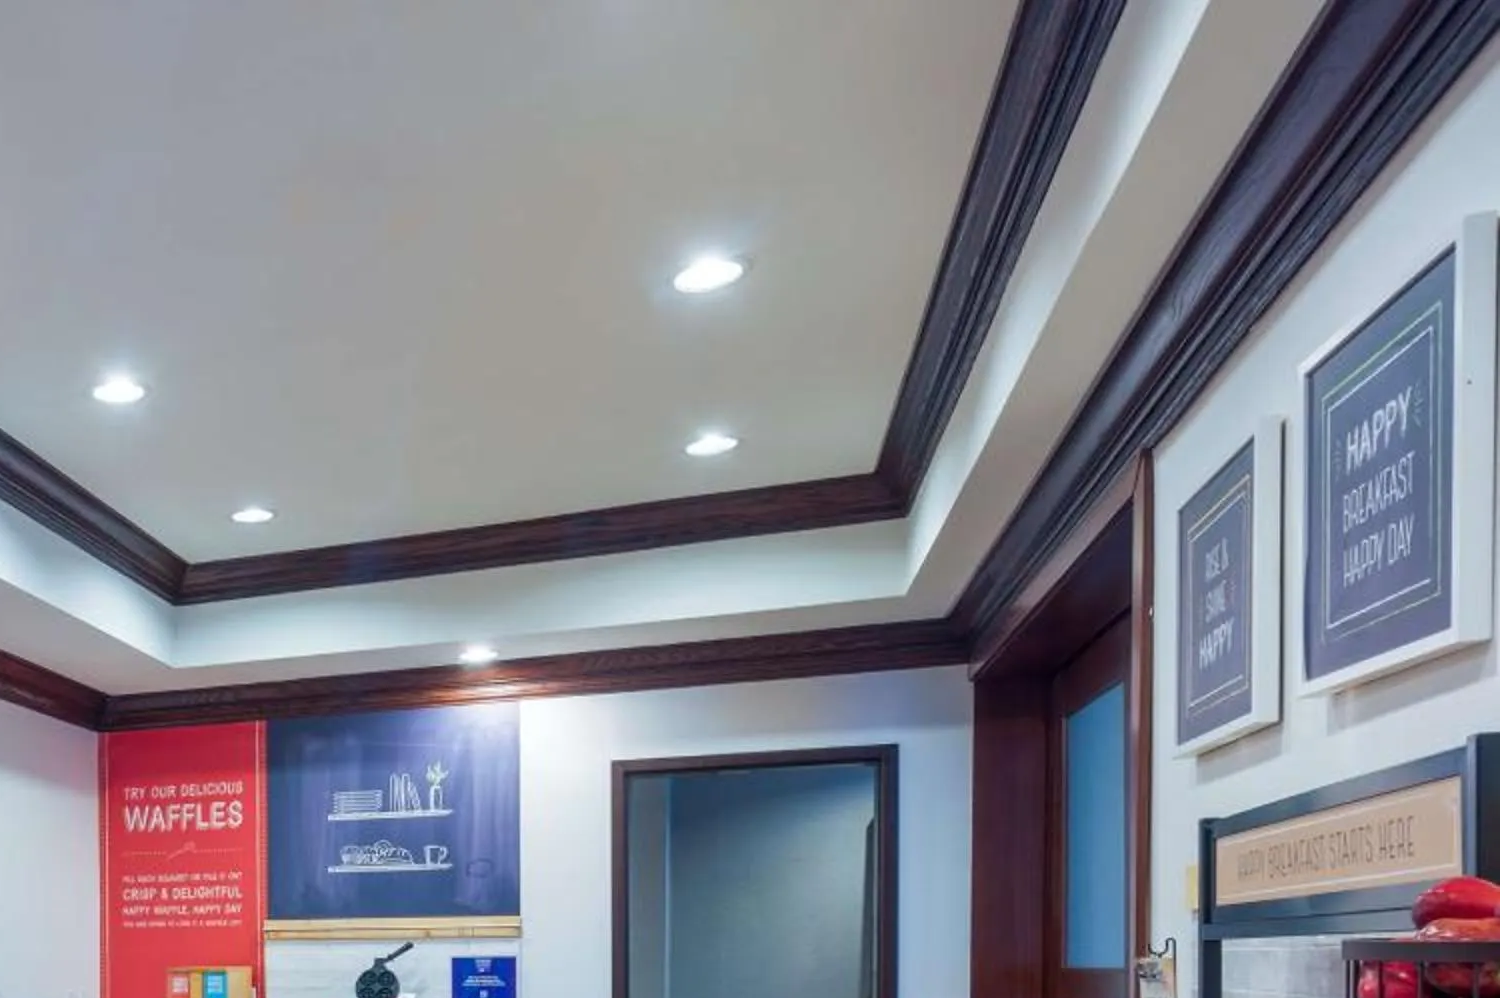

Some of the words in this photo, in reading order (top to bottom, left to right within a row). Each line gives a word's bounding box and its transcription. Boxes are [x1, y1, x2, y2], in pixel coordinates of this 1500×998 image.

[1345, 386, 1413, 475] HAPPY
[1342, 450, 1416, 534] BREAKFAST
[1343, 529, 1385, 589] HAPPY
[1387, 513, 1415, 565] DAY
[1199, 616, 1235, 669] HAPPY
[123, 800, 243, 833] WAFFLES
[124, 786, 146, 801] TRY
[151, 785, 177, 799] OUR
[181, 781, 243, 797] DELICIOUS
[1268, 835, 1325, 879] BREAKFAST
[1328, 825, 1374, 870] STARTS
[1378, 815, 1415, 861] HERE
[121, 904, 150, 916] HAPPY
[192, 903, 221, 915] HAPPY
[122, 886, 157, 901] CRISP
[161, 887, 169, 900] &
[171, 885, 243, 900] DELIGHTFUL
